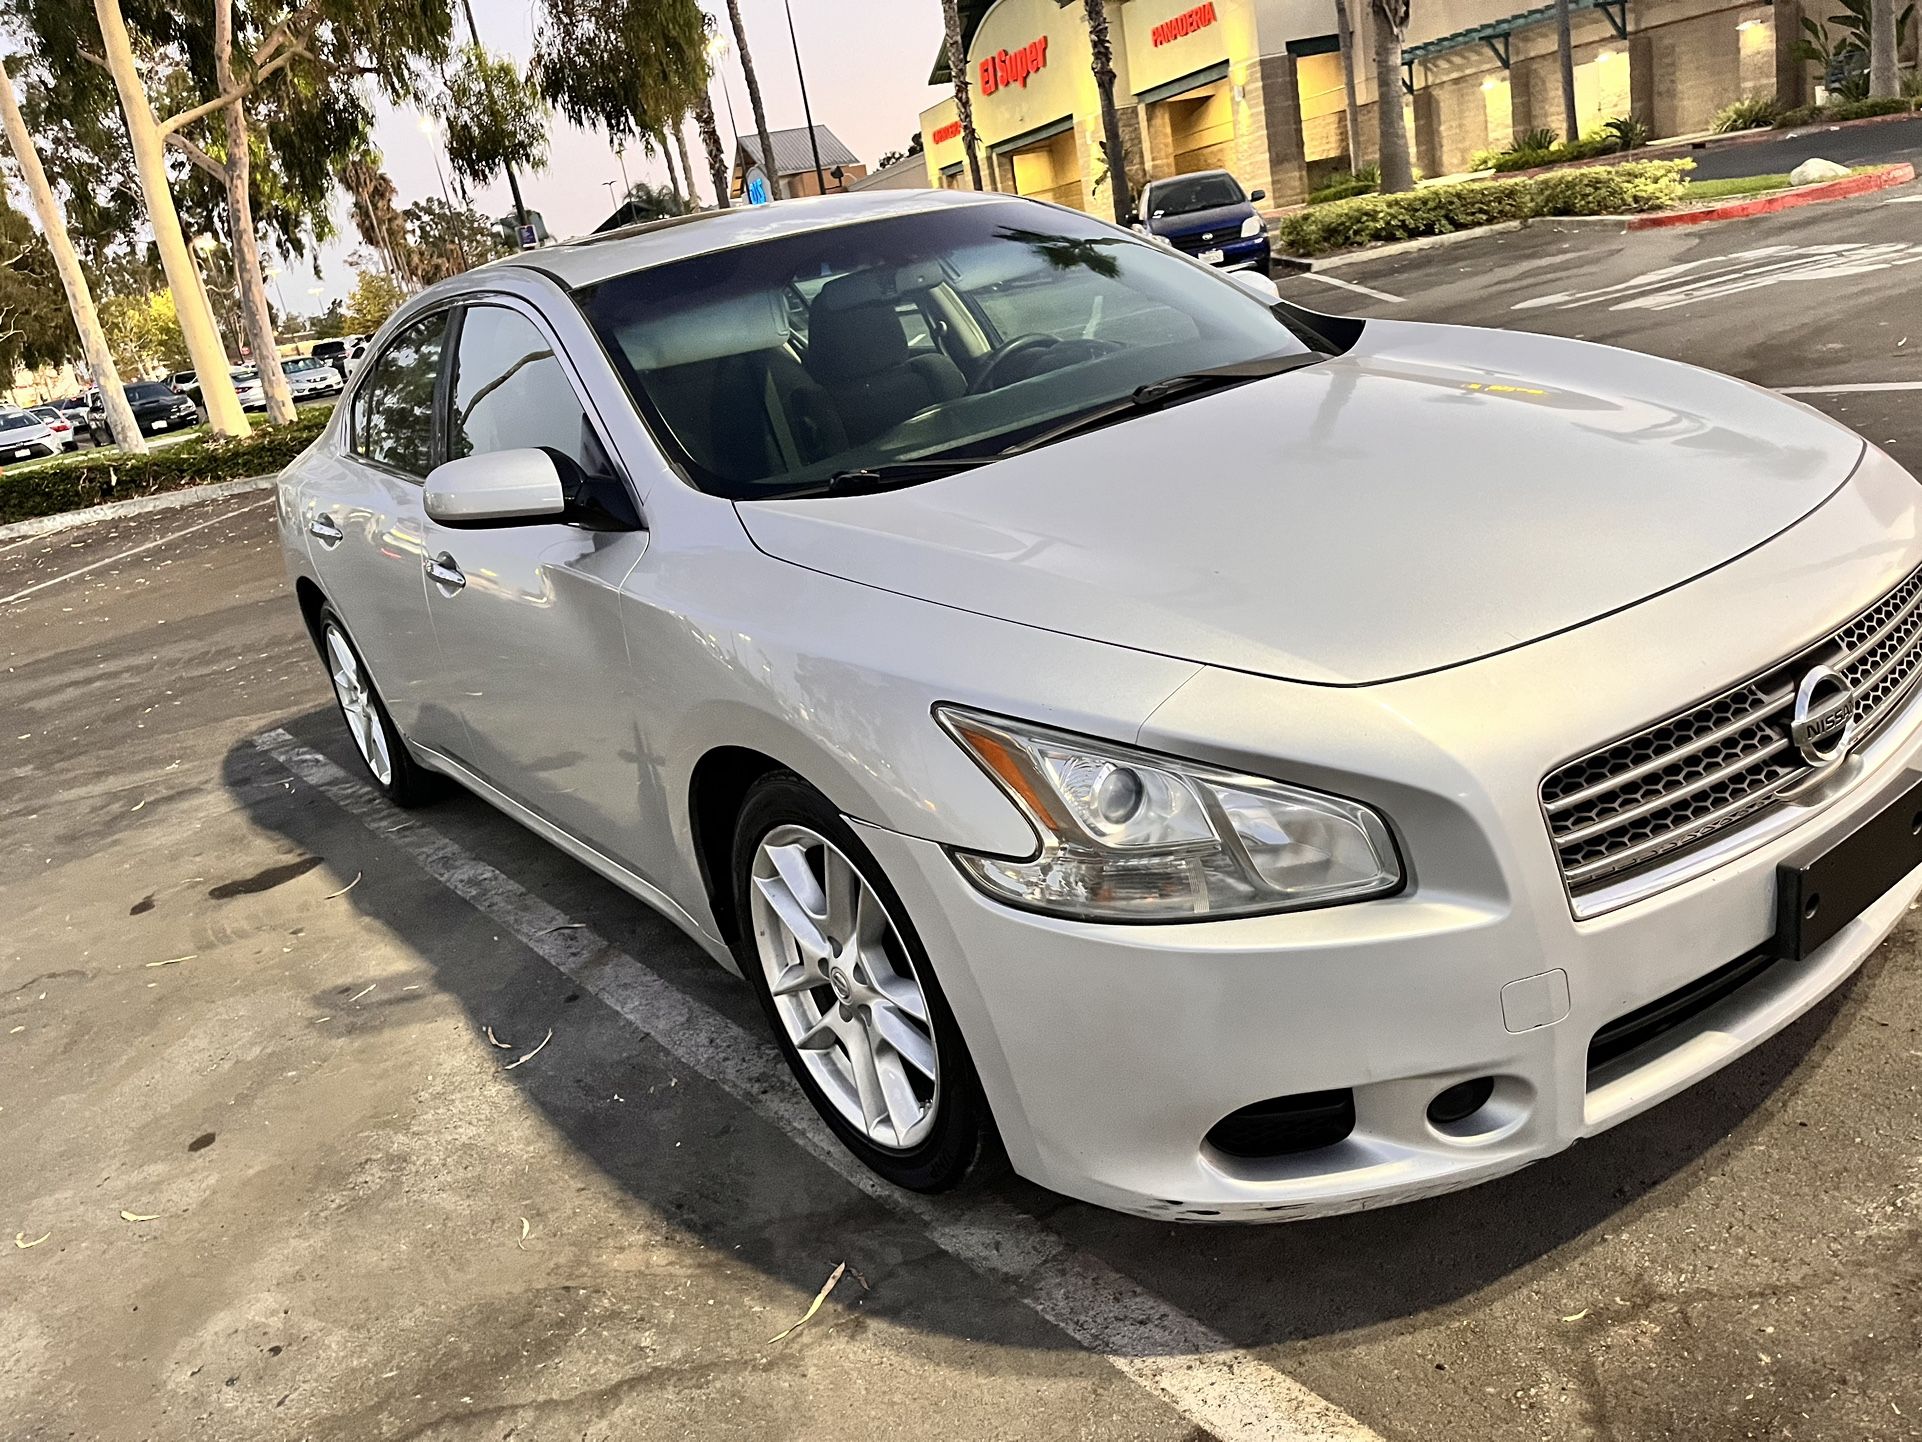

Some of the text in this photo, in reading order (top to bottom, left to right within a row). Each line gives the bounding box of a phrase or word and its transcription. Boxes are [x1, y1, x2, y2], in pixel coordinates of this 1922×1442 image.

[1152, 1, 1217, 47] PANADERIA
[979, 35, 1048, 96] El Super
